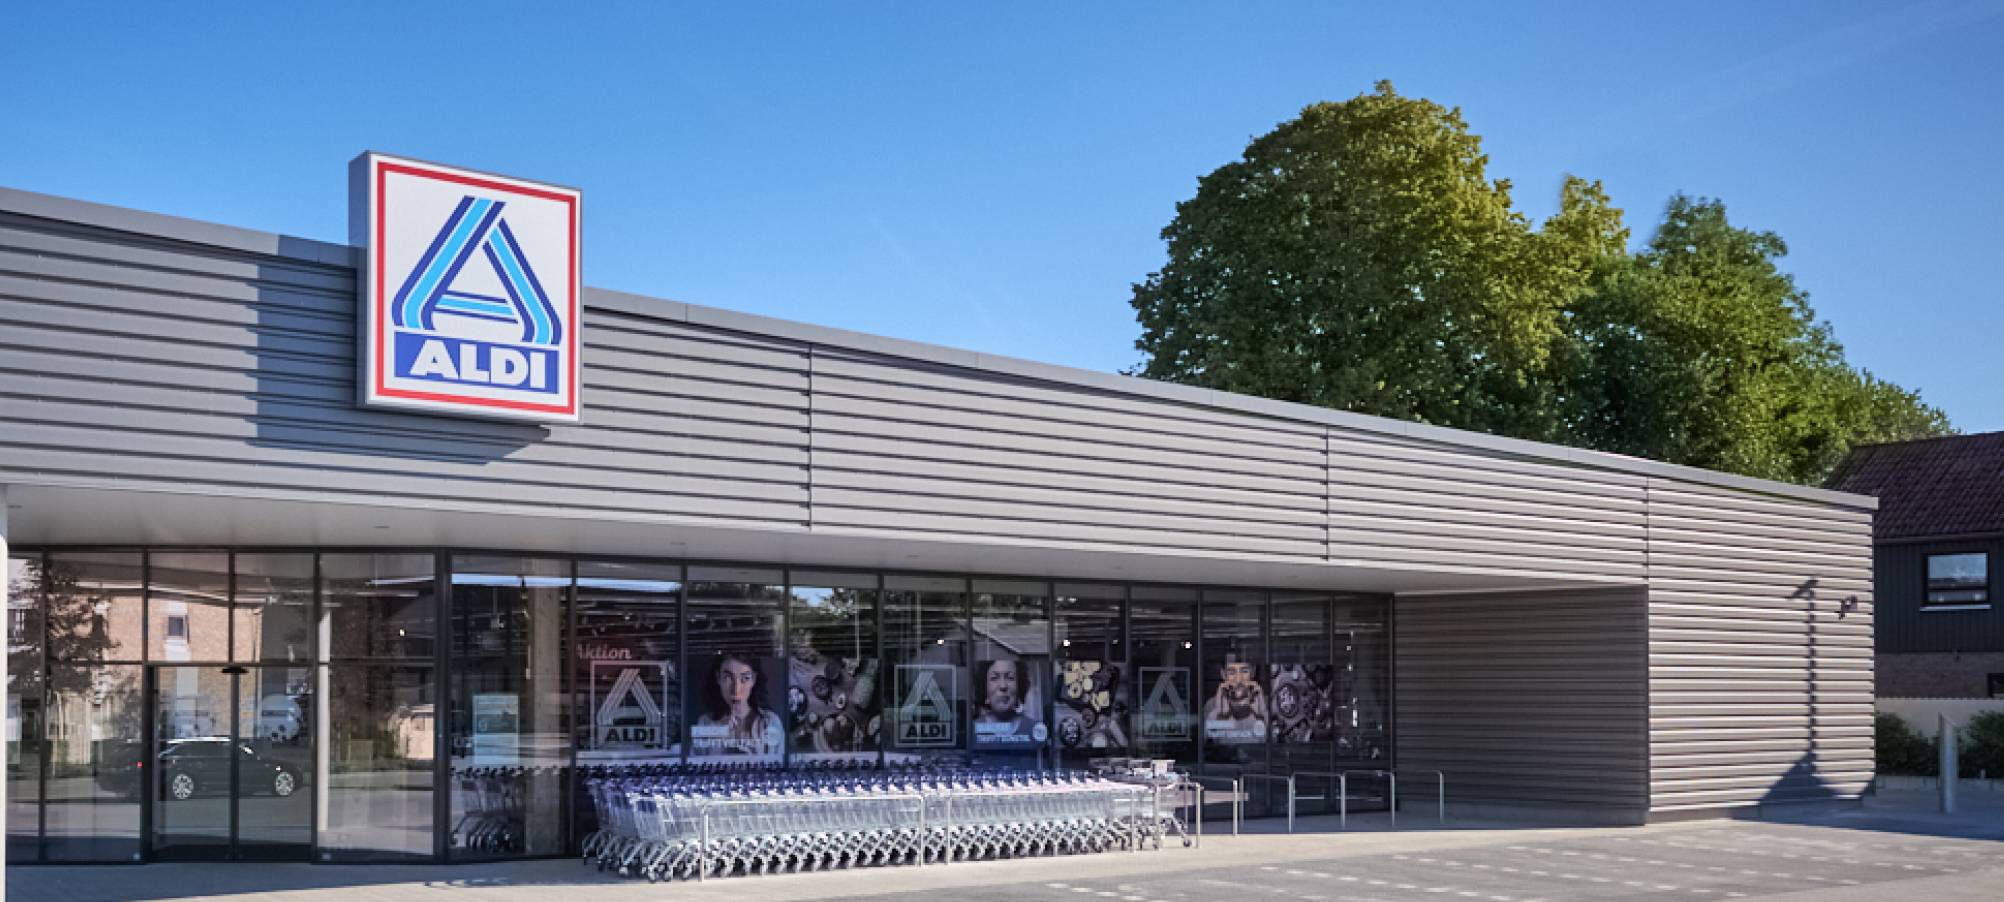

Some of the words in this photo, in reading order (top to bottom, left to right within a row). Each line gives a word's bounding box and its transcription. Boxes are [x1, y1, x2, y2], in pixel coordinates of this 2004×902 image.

[409, 339, 546, 389] ALDI
[604, 728, 655, 742] ALDI
[905, 724, 946, 738] ALDI
